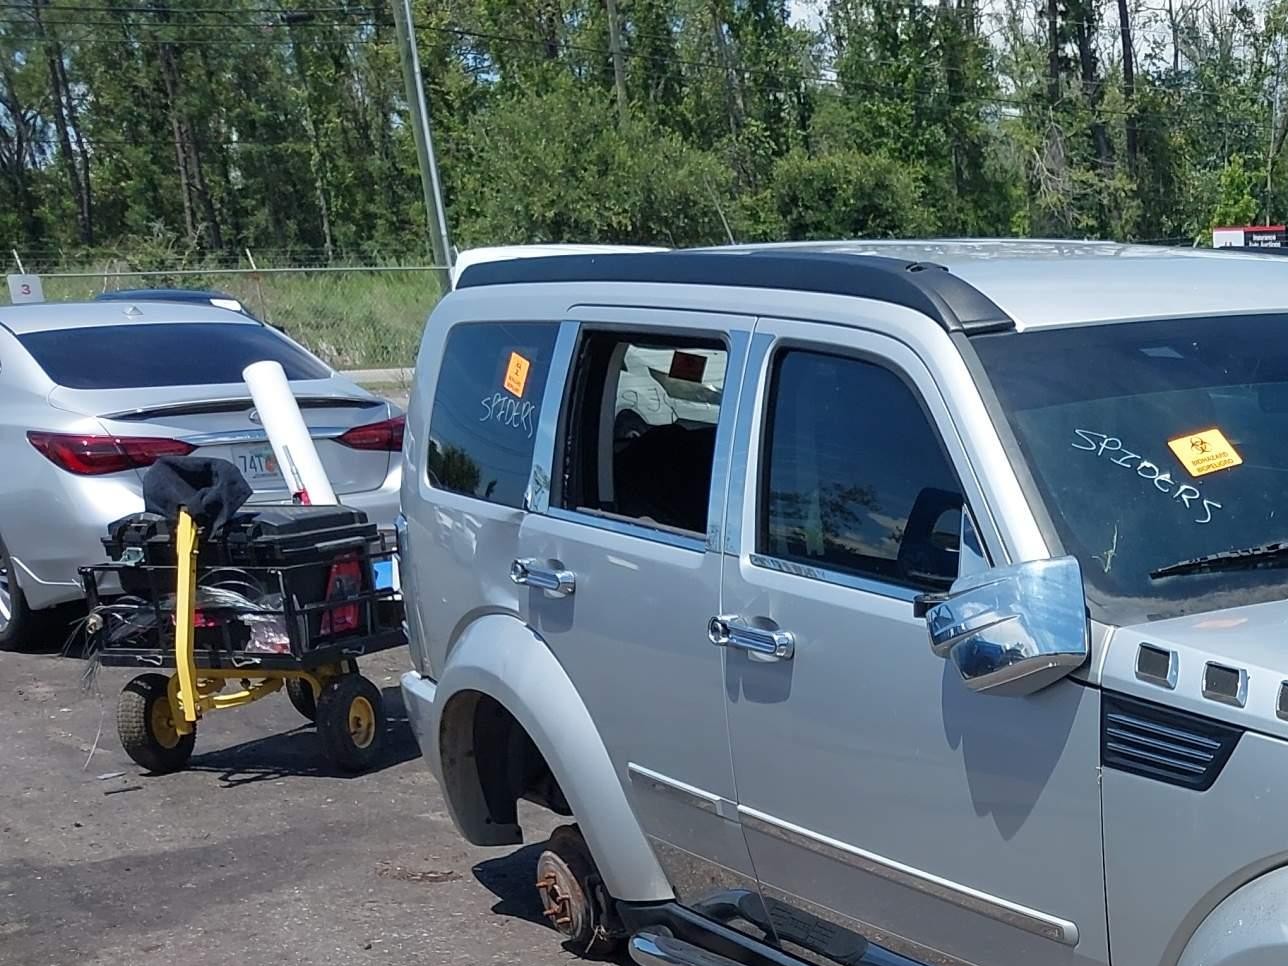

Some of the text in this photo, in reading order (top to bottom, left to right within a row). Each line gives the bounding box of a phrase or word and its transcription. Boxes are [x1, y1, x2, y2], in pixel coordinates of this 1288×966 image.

[20, 283, 32, 295] 3
[480, 392, 535, 439] SPIDERS
[1071, 428, 1223, 524] SPIDERS
